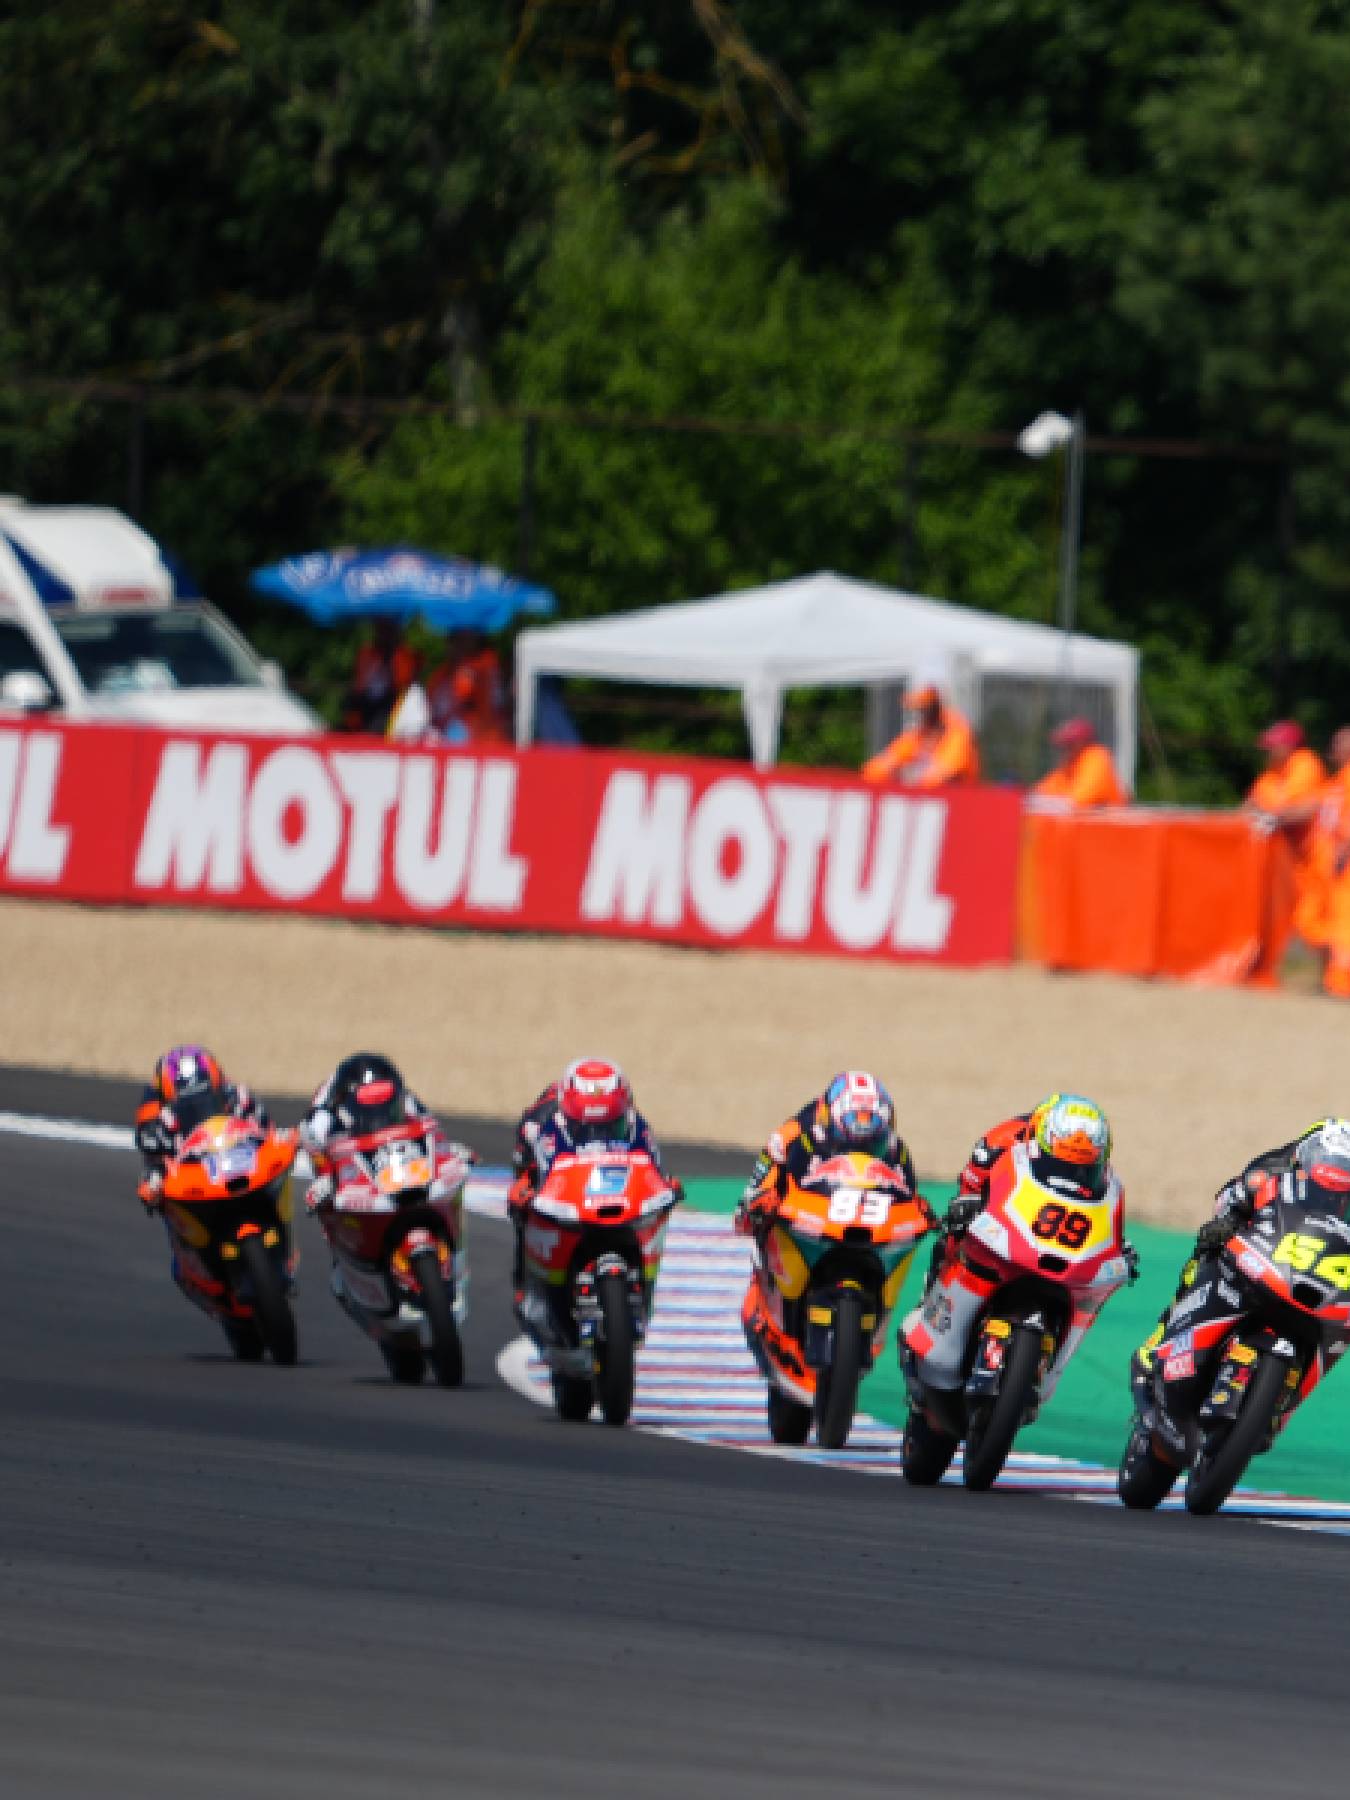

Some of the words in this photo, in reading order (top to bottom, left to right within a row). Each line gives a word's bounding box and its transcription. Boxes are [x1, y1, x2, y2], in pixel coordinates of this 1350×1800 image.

[134, 741, 528, 912] MOTUL
[581, 770, 954, 953] MOTUL
[828, 1188, 893, 1224] 83
